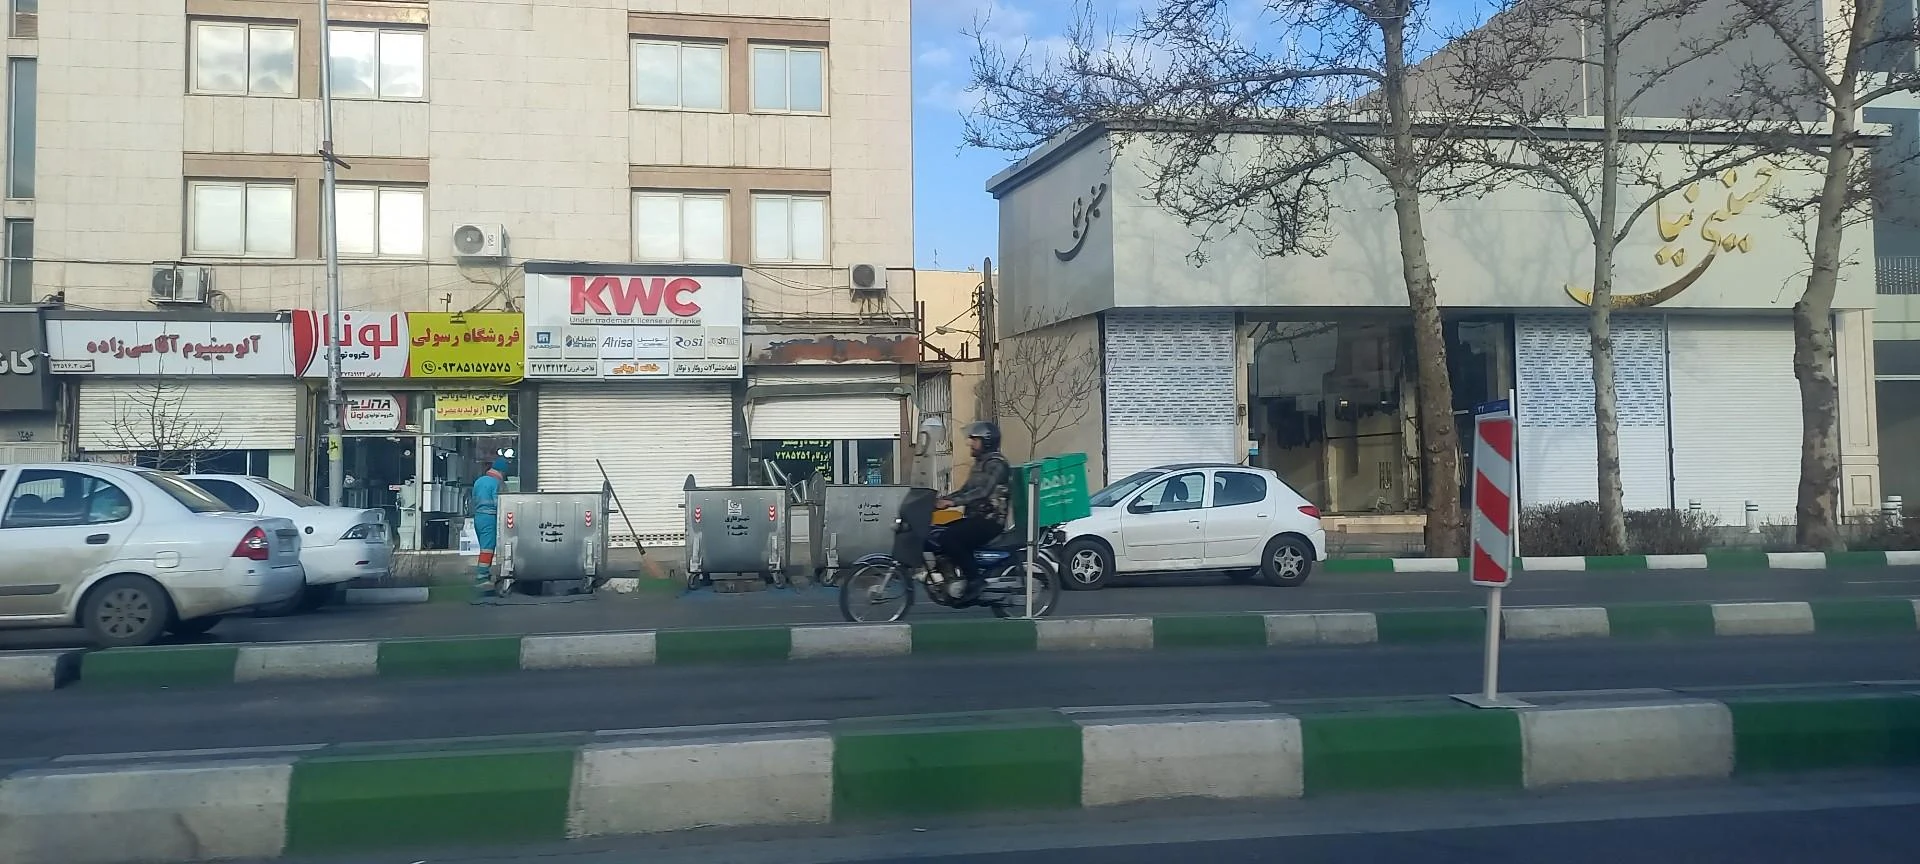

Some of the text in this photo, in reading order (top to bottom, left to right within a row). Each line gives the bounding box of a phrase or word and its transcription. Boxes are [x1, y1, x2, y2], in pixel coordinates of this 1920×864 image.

[571, 276, 701, 317] KWC
[323, 313, 399, 360] لونا
[411, 326, 520, 347] فروشگاه رسولی
[602, 336, 633, 348] Atrisa
[673, 334, 704, 349] Rosi
[182, 334, 261, 361] آلومینیوم
[438, 362, 511, 373] ۰۹۳۸۵۱۵۷۵۷۵
[486, 404, 506, 413] PVC
